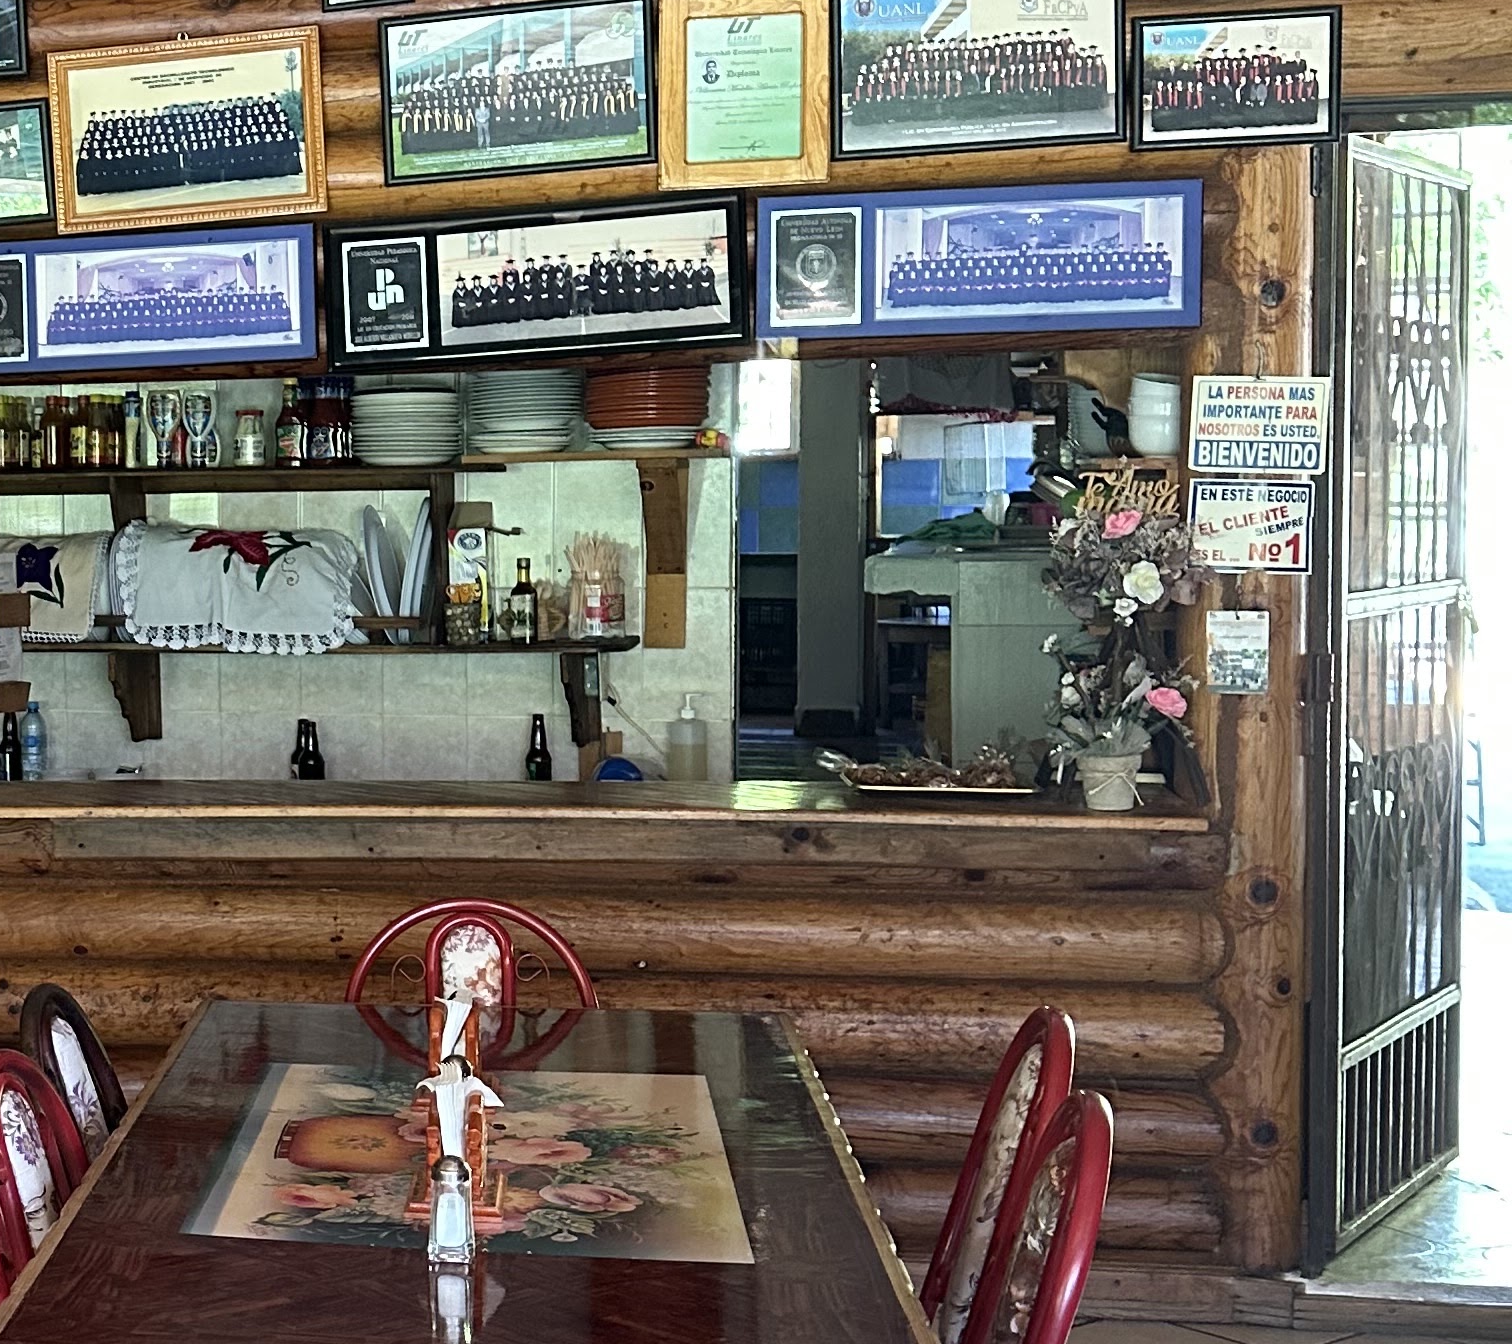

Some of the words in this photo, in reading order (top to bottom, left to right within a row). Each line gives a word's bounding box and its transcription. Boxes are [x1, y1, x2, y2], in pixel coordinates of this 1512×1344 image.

[878, 2, 926, 19] UANL
[727, 16, 761, 34] UT
[398, 29, 428, 46] UT
[1208, 385, 1223, 399] LA
[1227, 386, 1285, 400] PERSONA
[1289, 386, 1315, 400] MAS
[1203, 404, 1282, 419] IMPORTANTE
[1285, 406, 1317, 420] PARA
[1198, 423, 1260, 436] NOSOTROS
[1263, 424, 1277, 437] ES
[1280, 424, 1320, 439] USTED.
[1198, 441, 1318, 468] BIENVENIDO
[1111, 464, 1180, 496] Amo
[1201, 488, 1217, 501] EN
[1221, 489, 1253, 501] ESTE
[1258, 489, 1307, 503] NEGOCIO
[1198, 521, 1220, 536] EL
[1223, 505, 1290, 530] CLIENTE
[1255, 516, 1304, 536] SIEMPRE
[1212, 549, 1226, 561] EL
